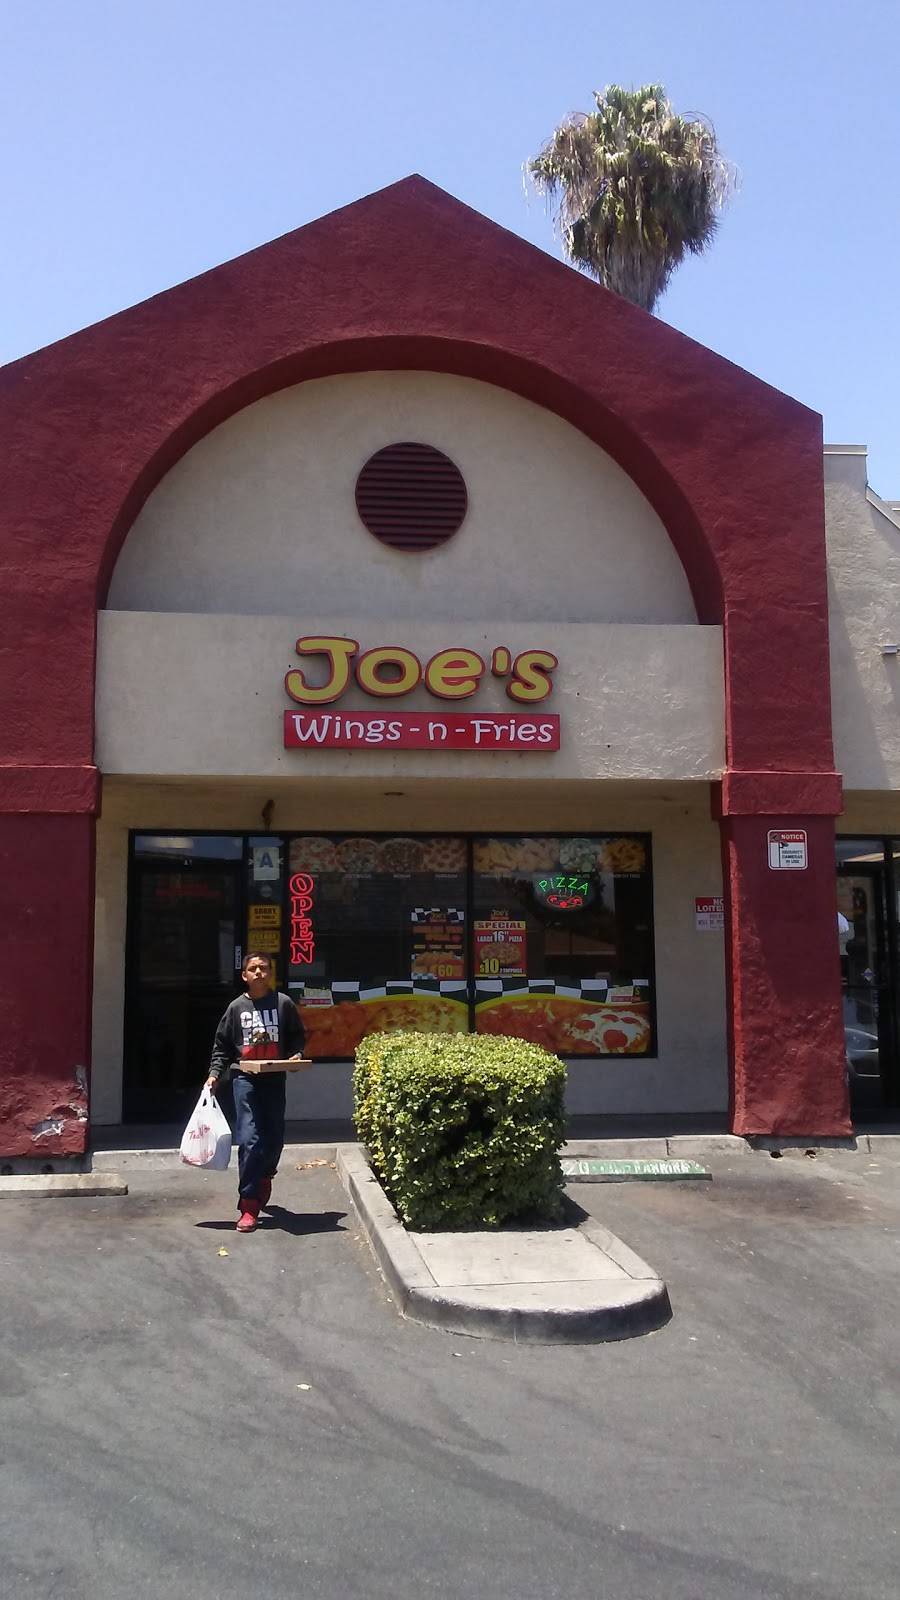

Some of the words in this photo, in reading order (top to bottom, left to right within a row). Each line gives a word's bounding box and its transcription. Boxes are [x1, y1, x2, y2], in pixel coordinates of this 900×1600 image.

[285, 636, 558, 704] Joe's
[260, 852, 273, 868] A
[539, 877, 589, 895] PIZZA
[289, 873, 315, 964] OPEN
[478, 921, 523, 929] SPECIAL
[240, 1009, 279, 1028] CALI
